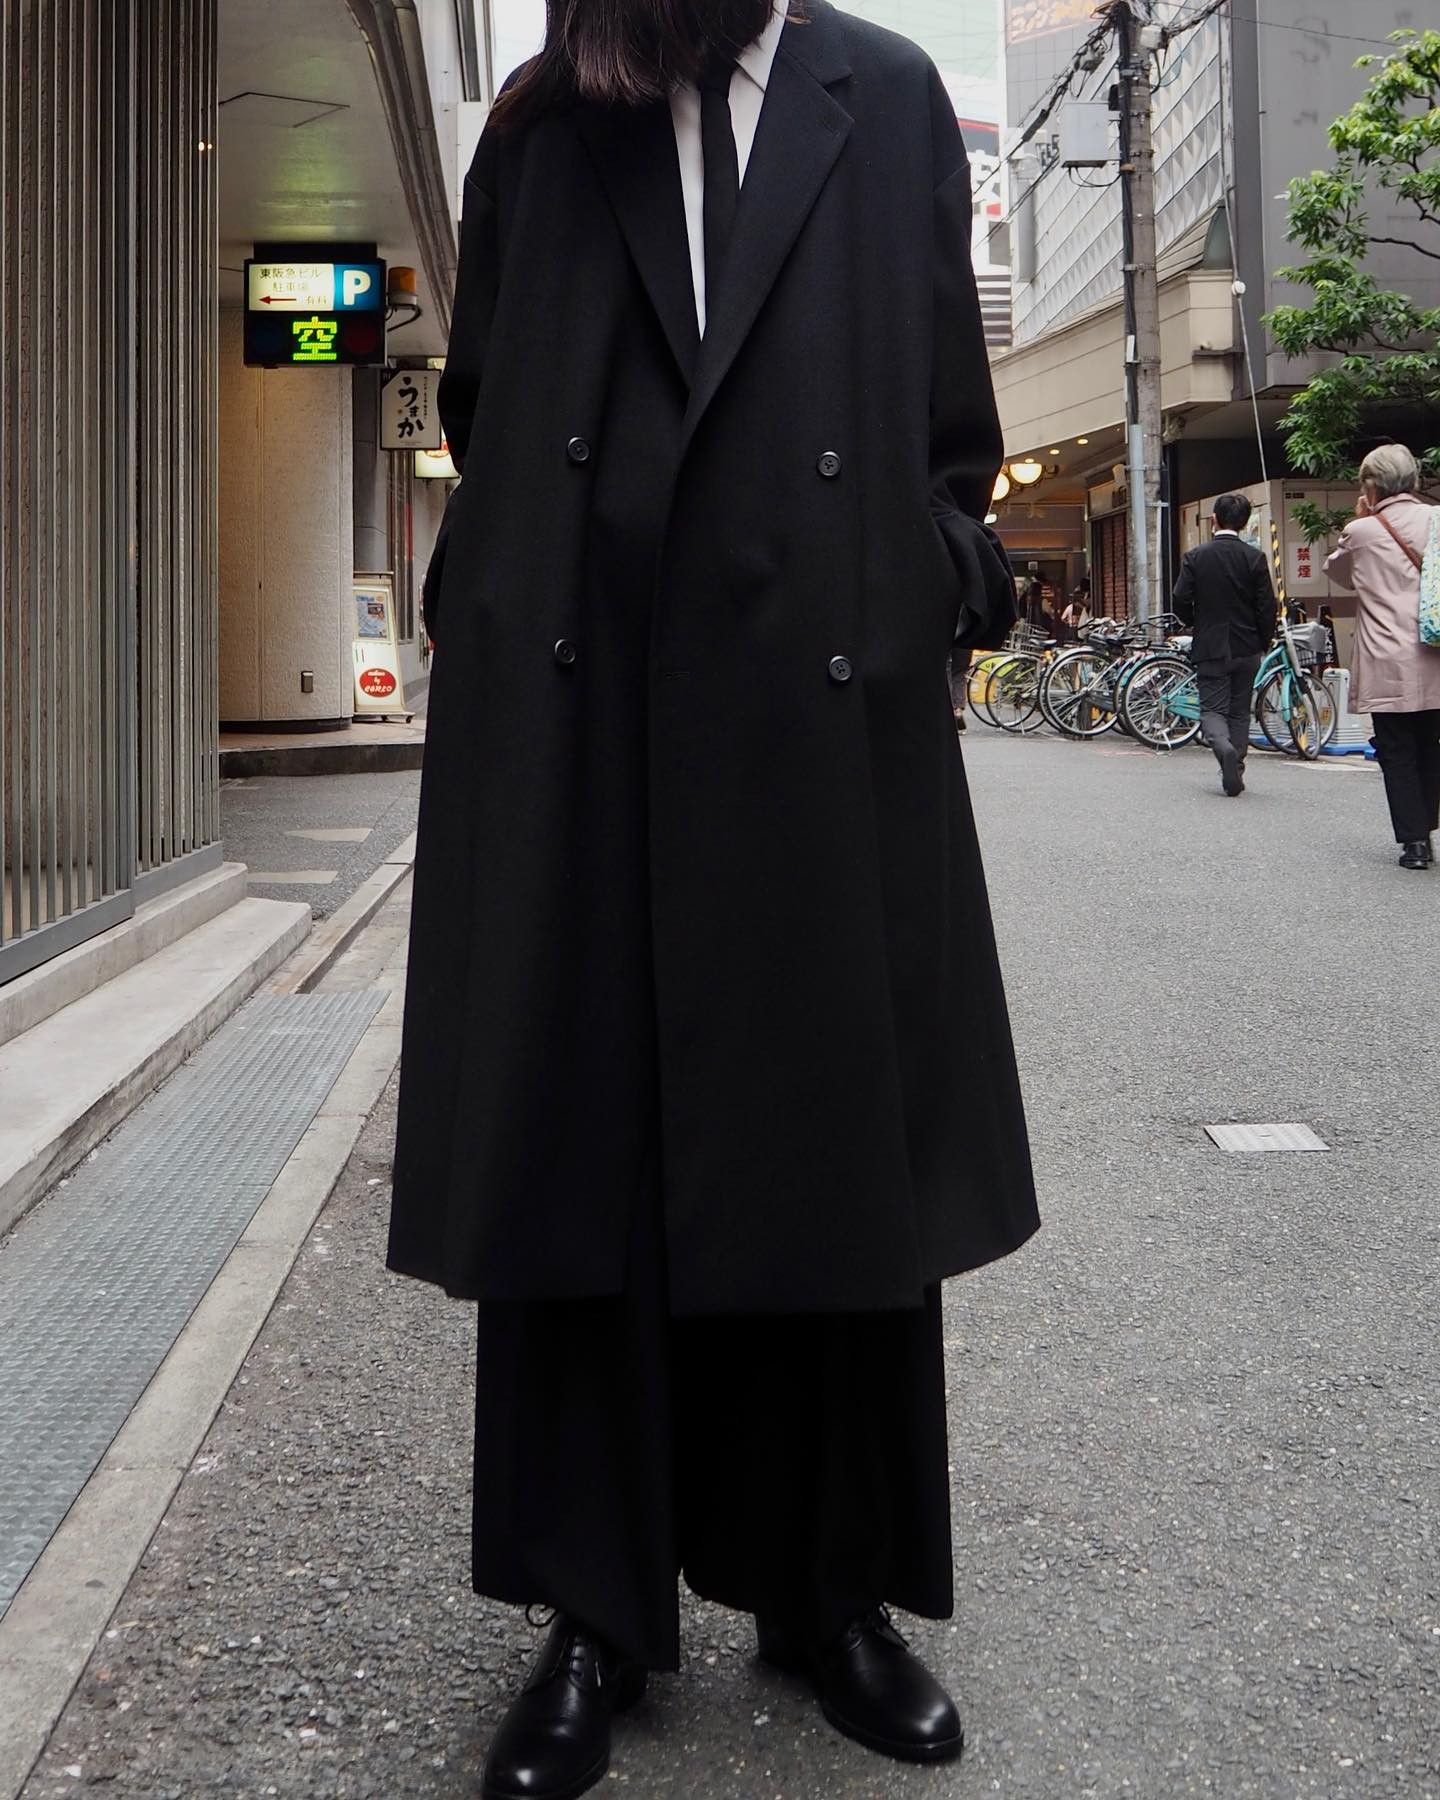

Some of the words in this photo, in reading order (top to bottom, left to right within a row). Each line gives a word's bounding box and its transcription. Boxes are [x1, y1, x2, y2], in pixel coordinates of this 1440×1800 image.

[343, 270, 371, 305] P
[292, 315, 337, 360] 空
[397, 376, 425, 439] うまか
[1297, 547, 1311, 578] 禁煙
